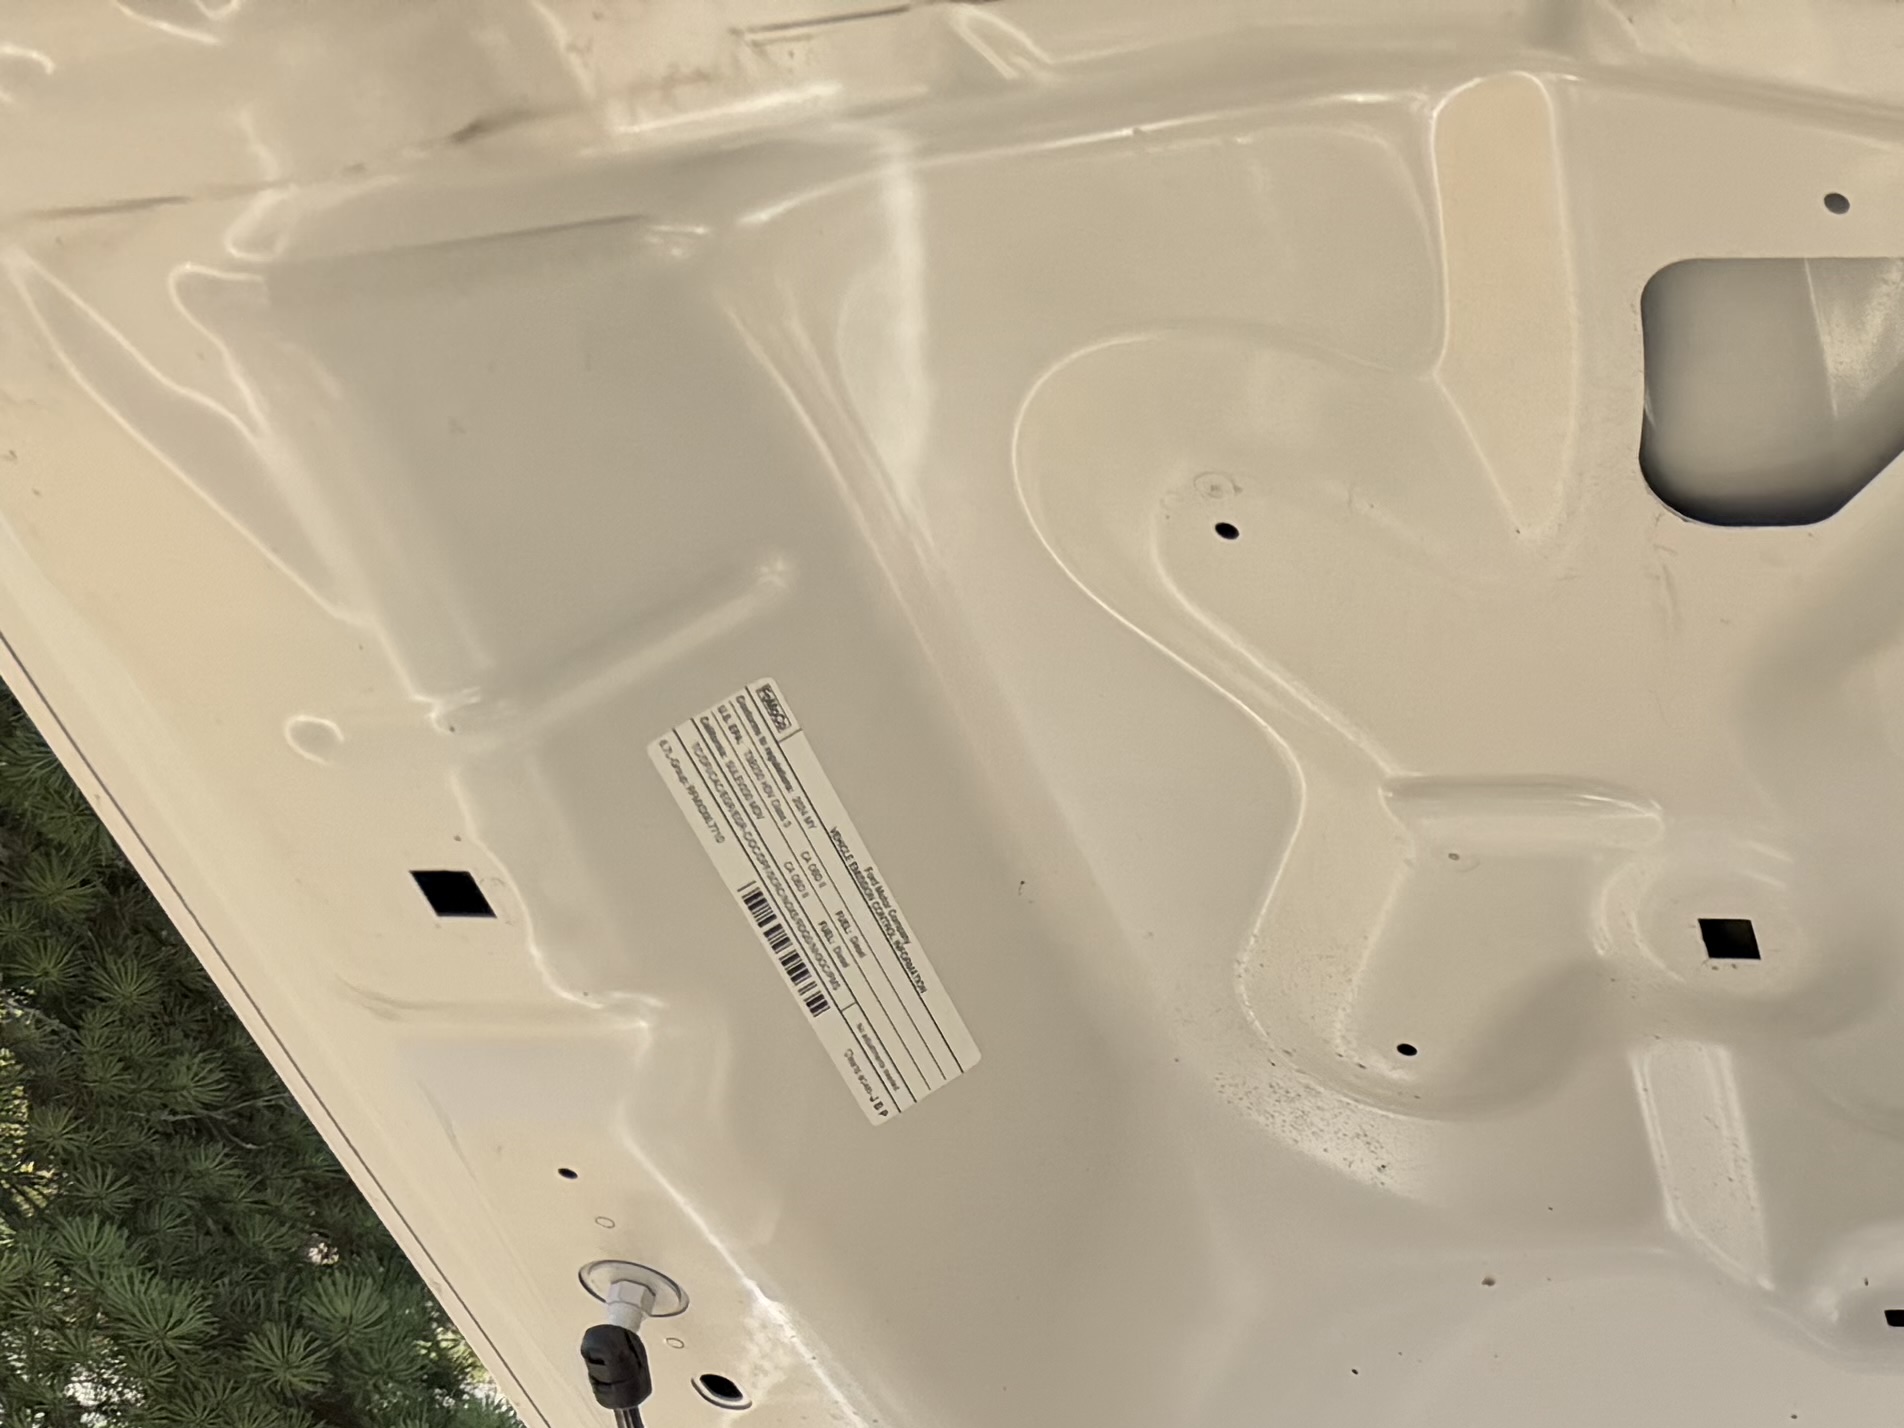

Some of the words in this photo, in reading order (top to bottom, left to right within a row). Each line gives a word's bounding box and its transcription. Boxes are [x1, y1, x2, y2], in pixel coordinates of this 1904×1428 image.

[829, 826, 853, 861] VEHICLE
[848, 860, 875, 901] EMISSION
[870, 900, 897, 939] CONTROL
[892, 938, 928, 994] INFORMATION
[863, 865, 880, 887] Ford
[873, 884, 893, 910] Motor
[884, 907, 912, 946] Company
